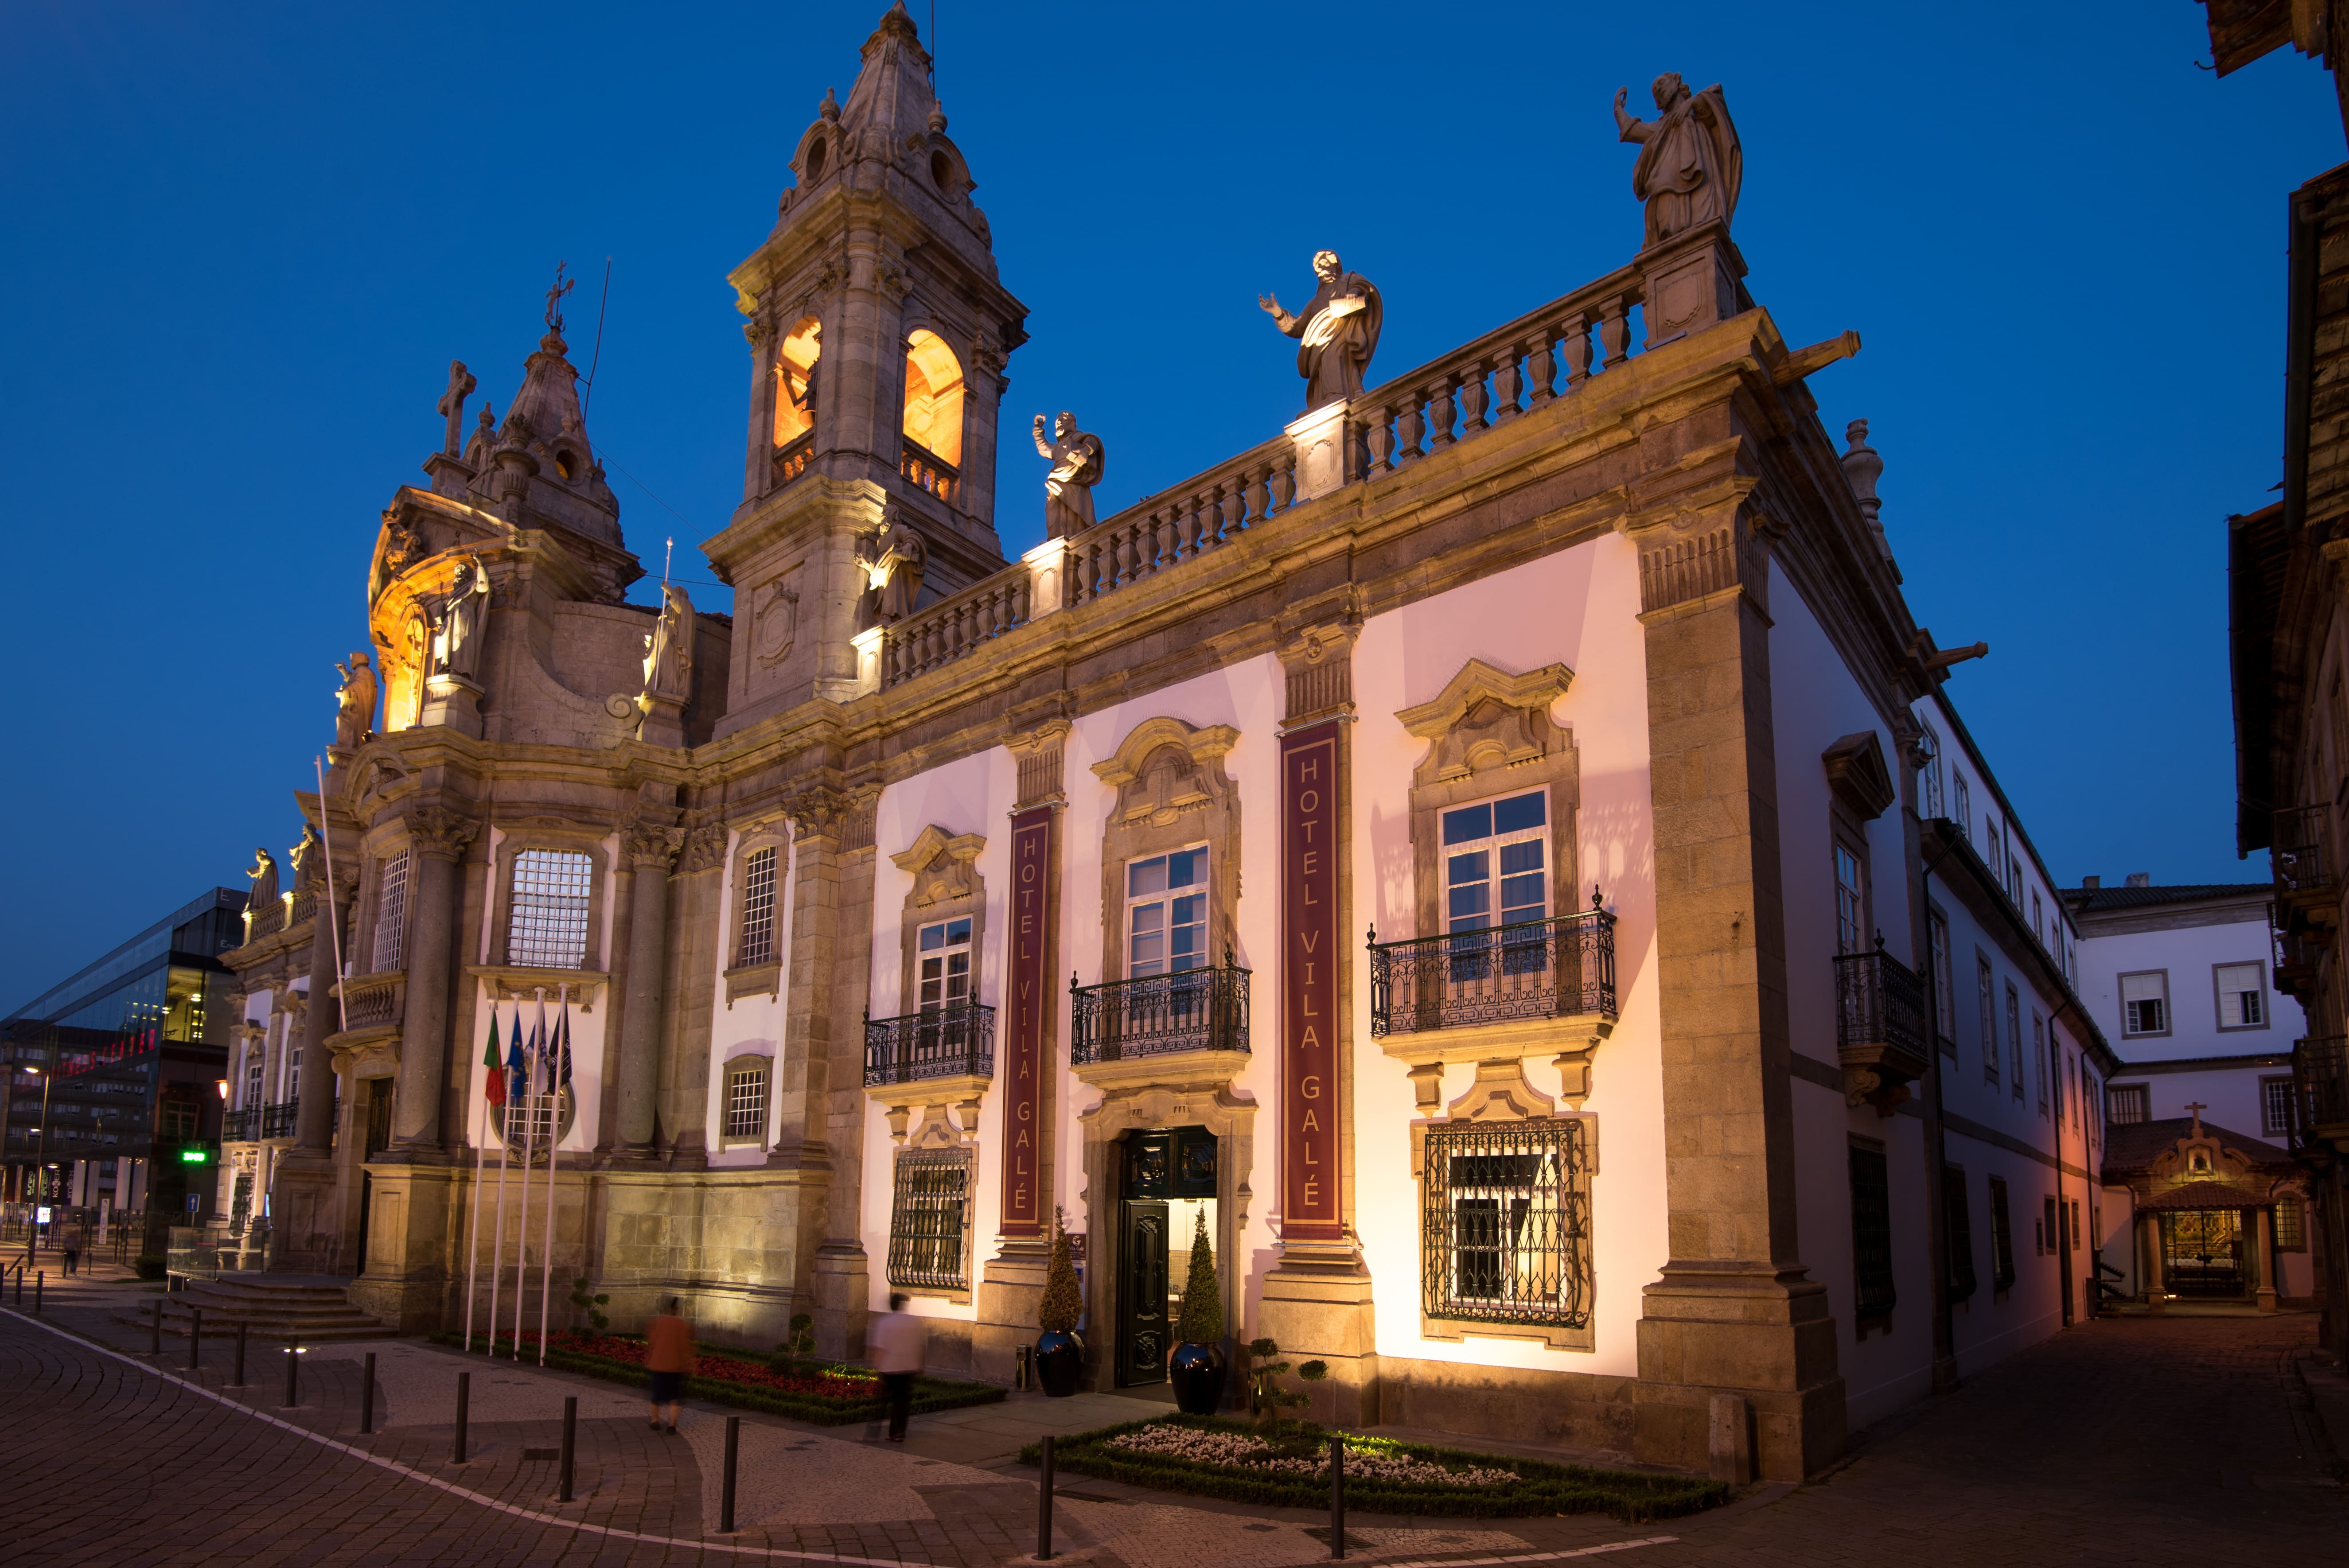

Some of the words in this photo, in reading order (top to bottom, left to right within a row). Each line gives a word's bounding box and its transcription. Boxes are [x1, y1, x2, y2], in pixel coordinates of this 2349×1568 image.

[1300, 758, 1319, 906] HOTEL
[1021, 837, 1036, 960] HOTEL
[1019, 980, 1030, 1079] VILA
[1301, 930, 1319, 1048] VILA
[52, 1169, 61, 1198] KOKER
[1015, 1101, 1030, 1208] GALÉ
[1301, 1075, 1320, 1206] GALÉ
